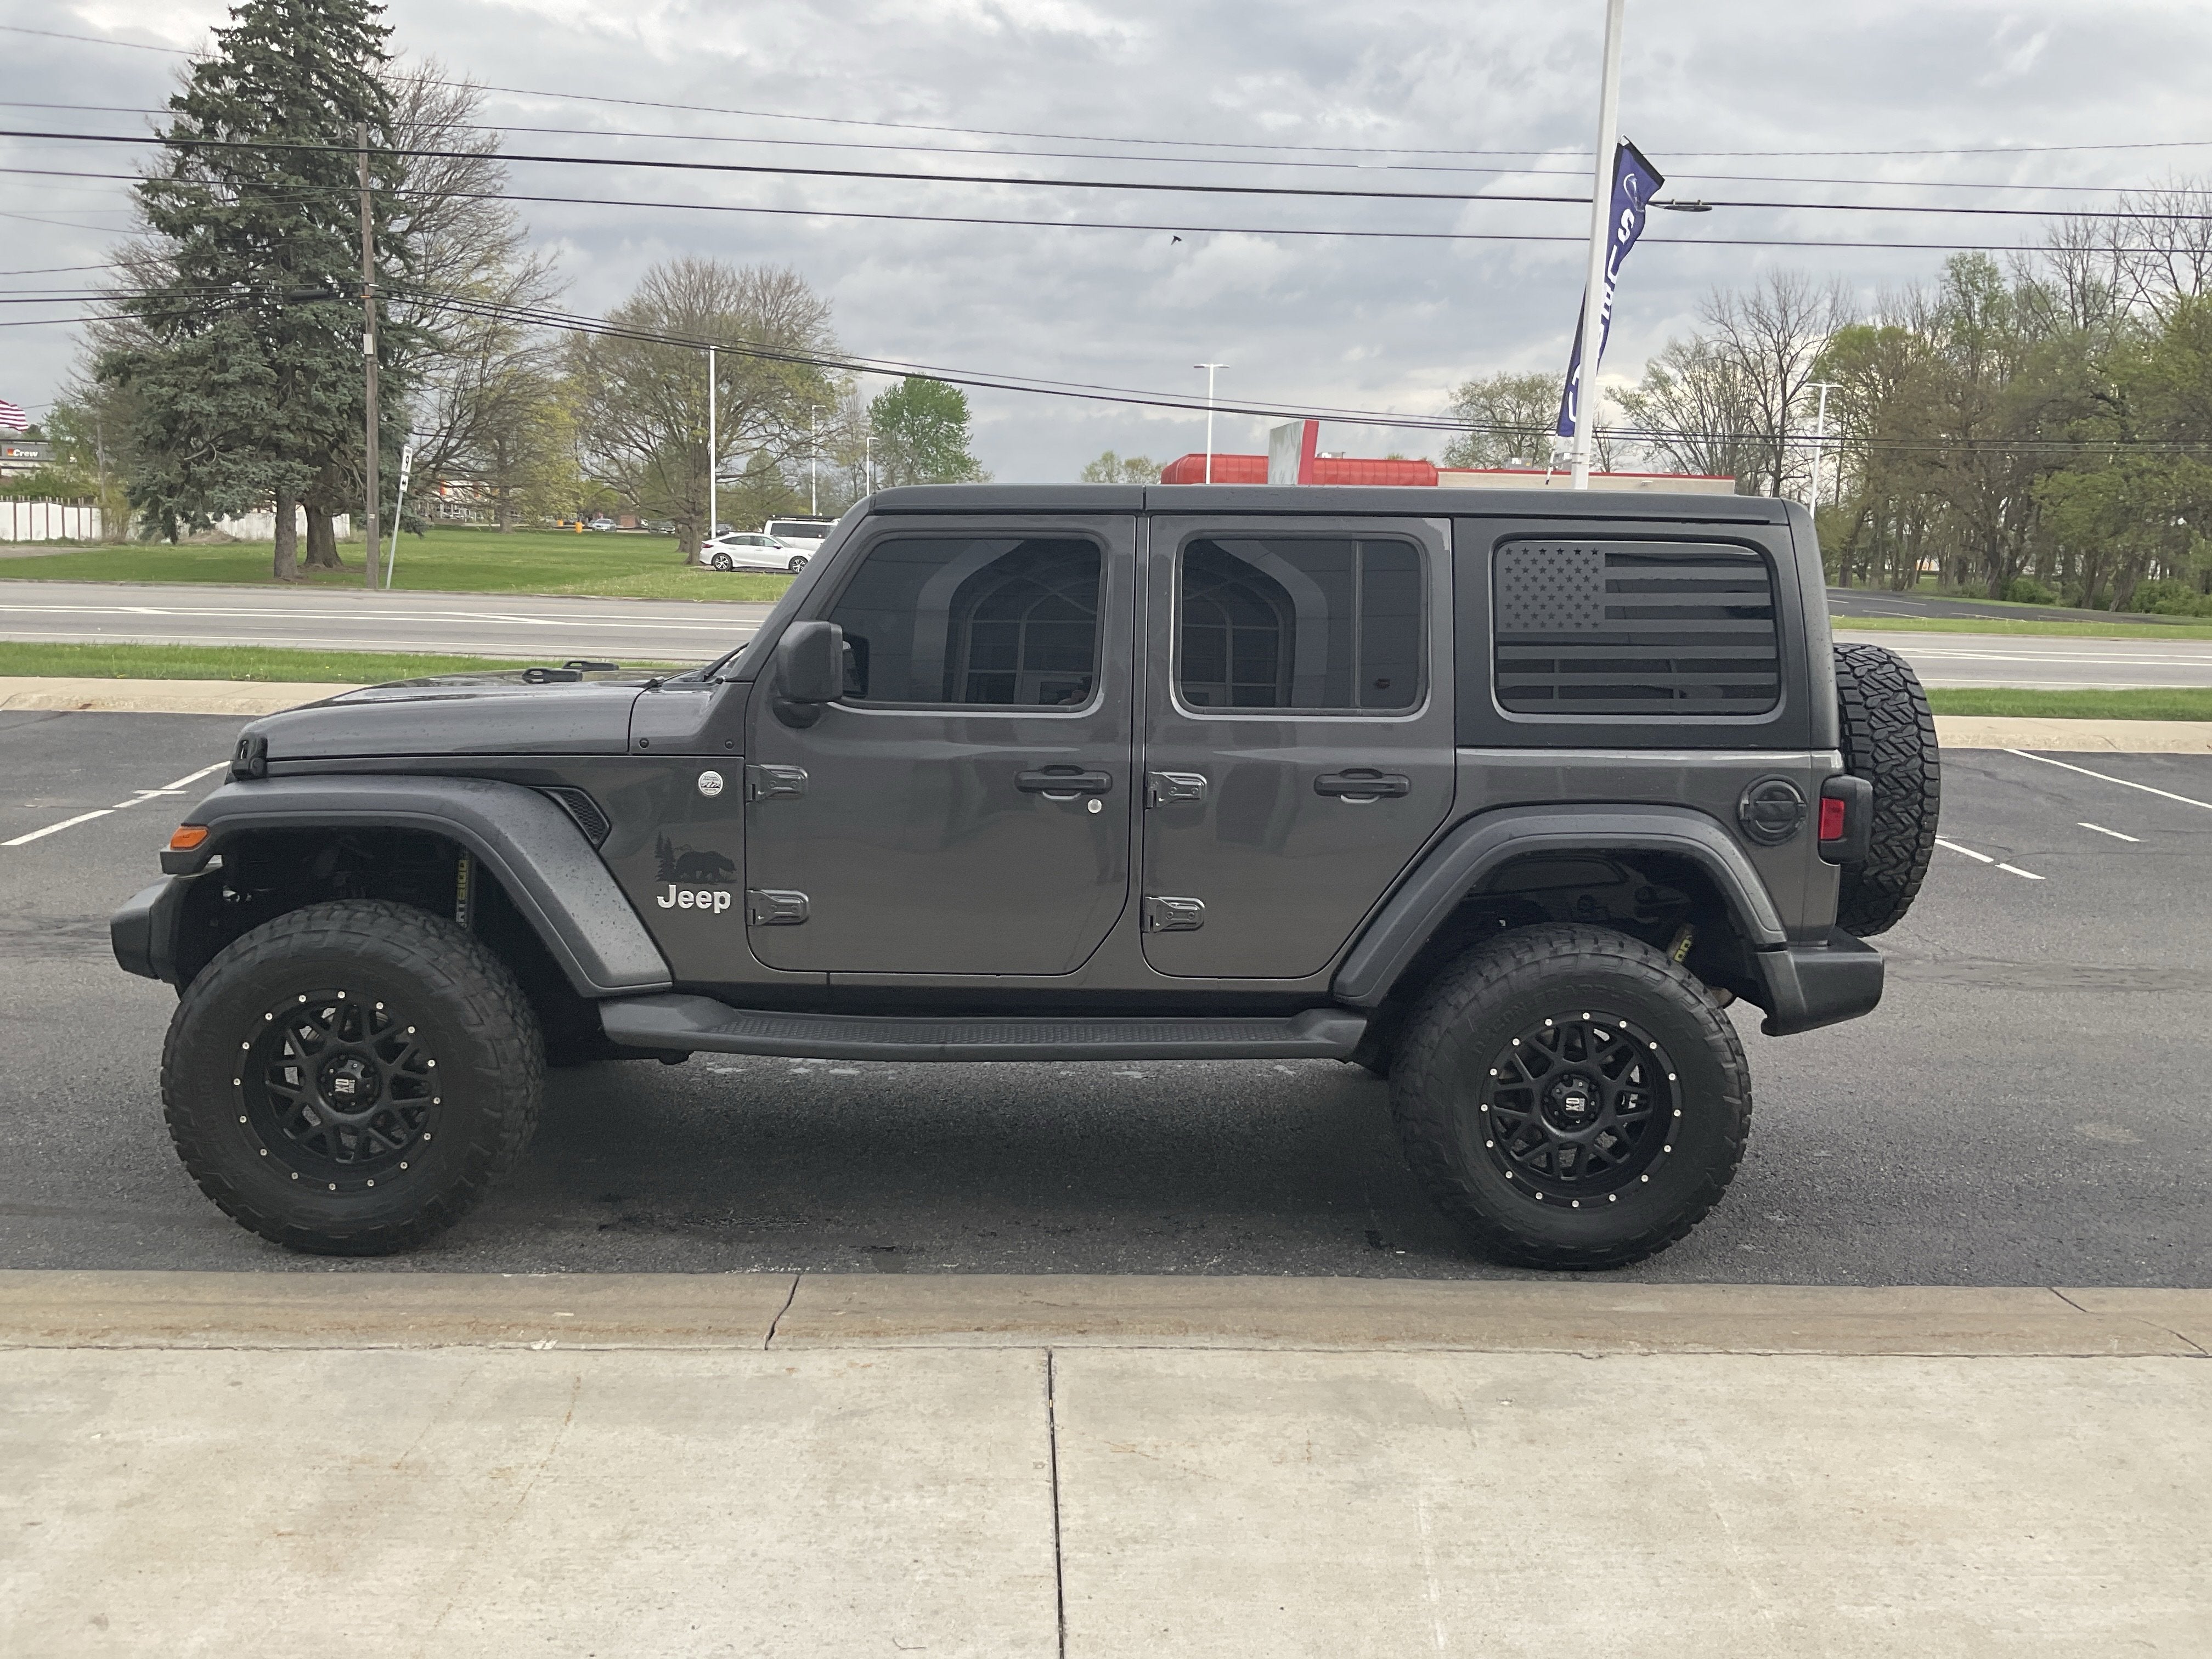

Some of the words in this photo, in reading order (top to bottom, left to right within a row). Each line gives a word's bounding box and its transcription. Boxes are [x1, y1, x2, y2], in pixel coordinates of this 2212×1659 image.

[13, 449, 38, 457] Crew
[657, 884, 731, 914] Jeep
[335, 1078, 349, 1093] XD
[1566, 1097, 1580, 1111] XD
